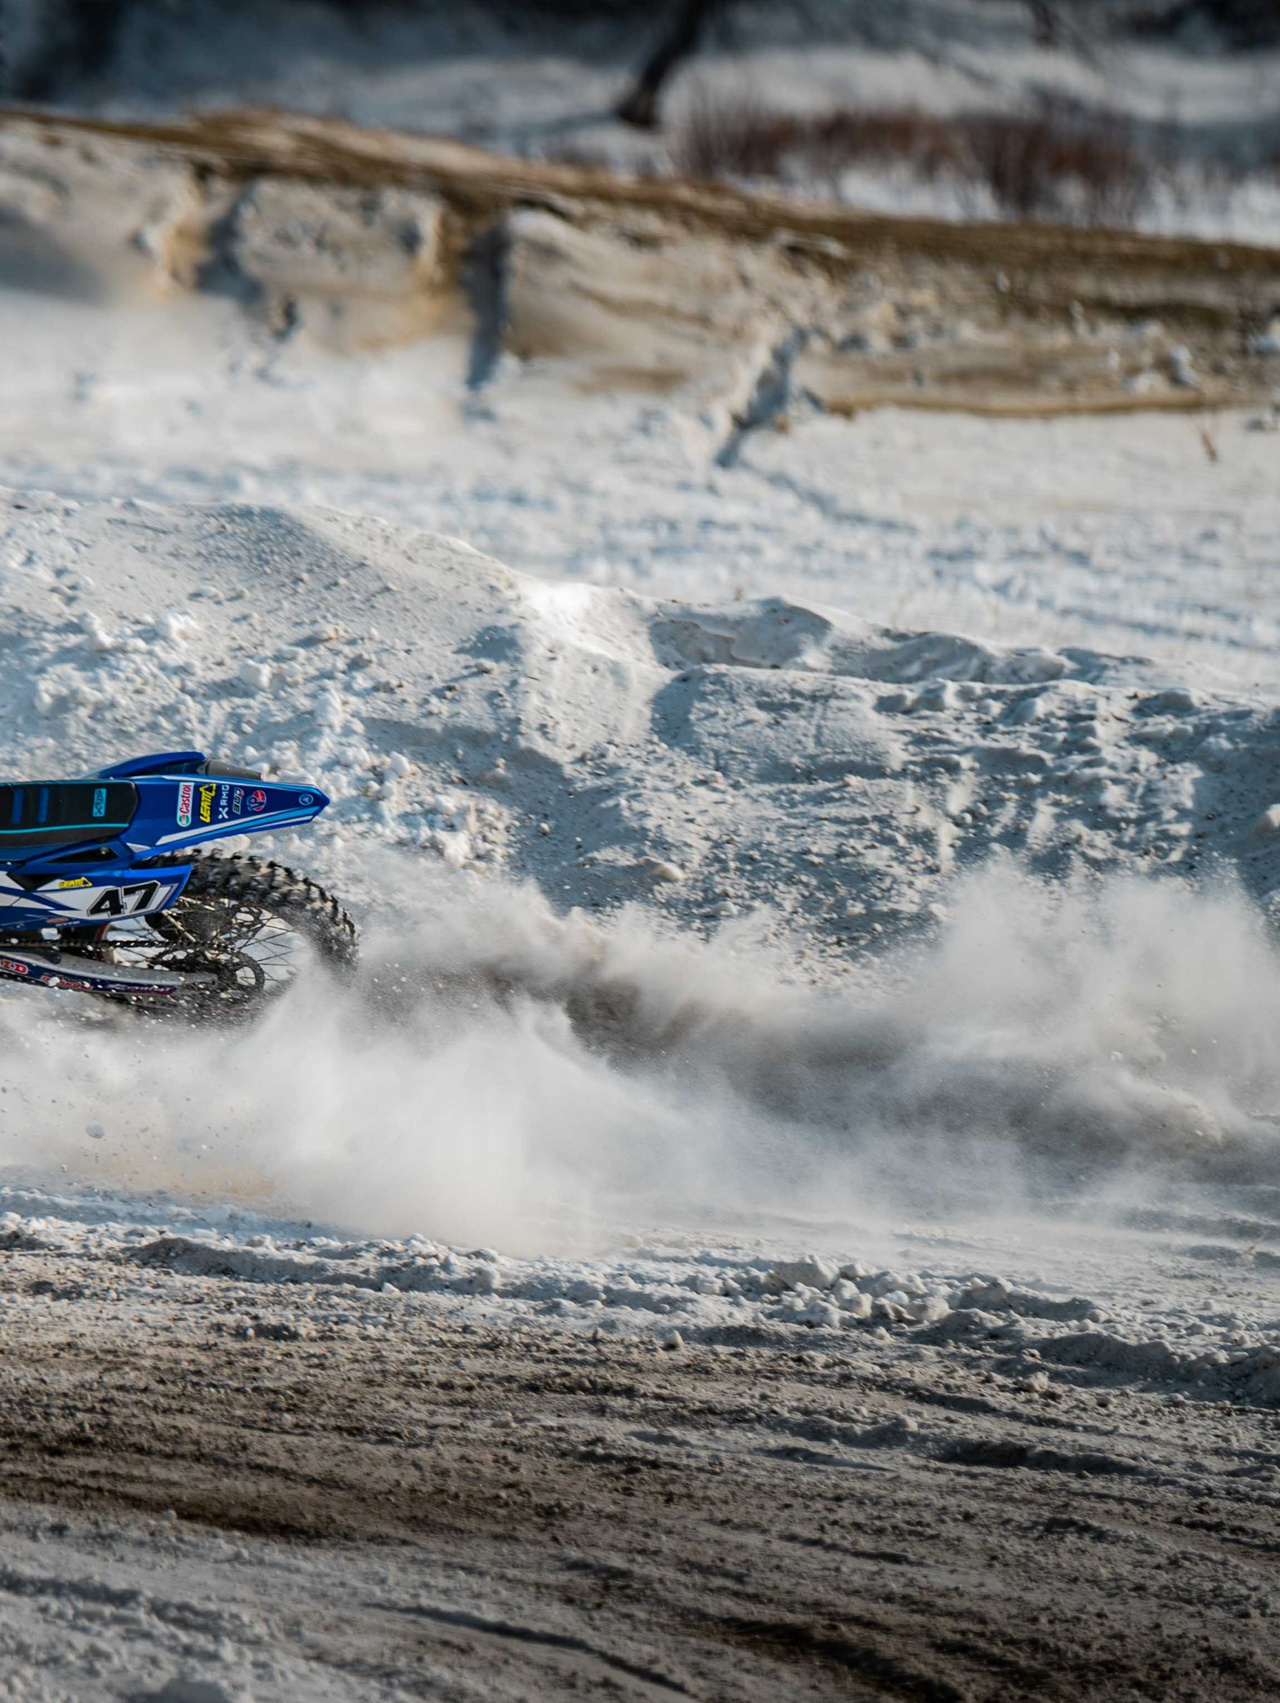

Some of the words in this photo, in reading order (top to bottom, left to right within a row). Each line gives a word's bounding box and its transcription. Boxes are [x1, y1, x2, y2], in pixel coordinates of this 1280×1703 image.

[179, 784, 192, 814] Castrol
[199, 783, 217, 823] LEATT
[87, 880, 160, 917] 47
